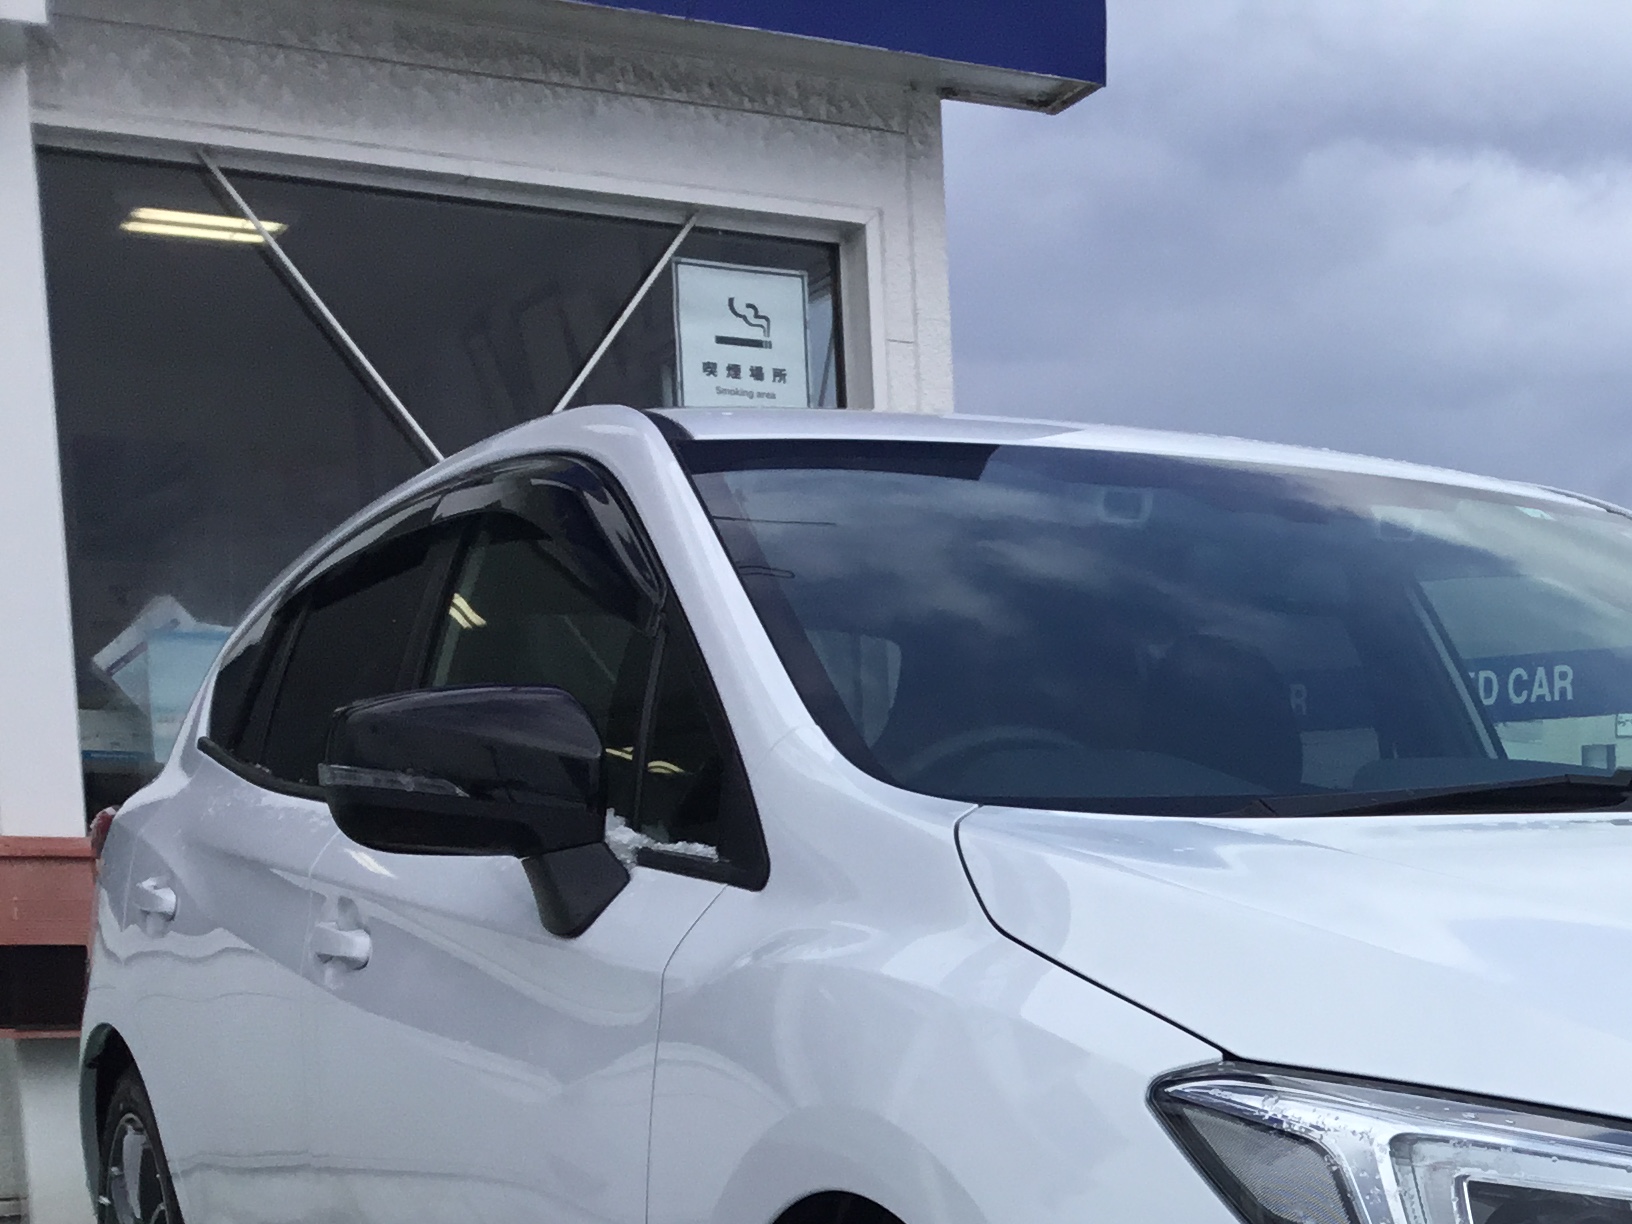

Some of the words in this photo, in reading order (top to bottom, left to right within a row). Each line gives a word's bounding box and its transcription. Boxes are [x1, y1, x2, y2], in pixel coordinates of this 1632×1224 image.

[702, 361, 787, 384] 喫煙場所
[716, 386, 754, 399] Smoking
[756, 391, 776, 399] area
[1507, 664, 1573, 704] CAR
